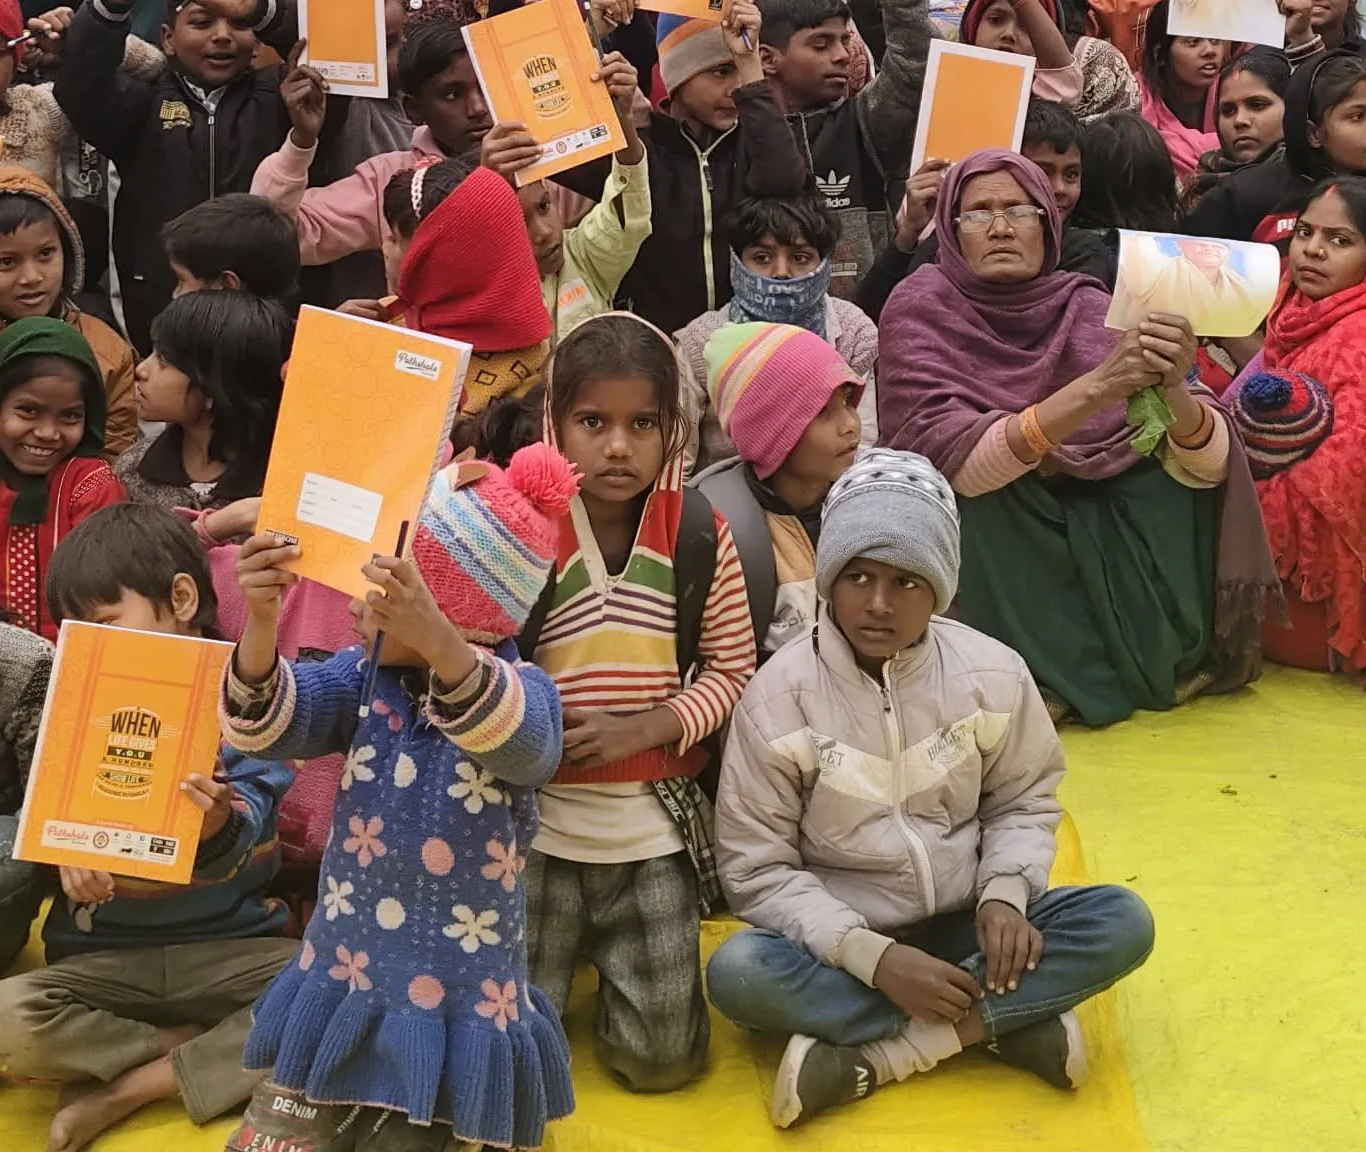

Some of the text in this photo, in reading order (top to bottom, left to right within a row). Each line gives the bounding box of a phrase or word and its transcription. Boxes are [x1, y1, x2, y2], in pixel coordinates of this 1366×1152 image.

[523, 57, 557, 79] WHEN
[110, 711, 162, 738] WHEN
[819, 750, 846, 767] LET
[272, 1096, 318, 1120] DENIM
